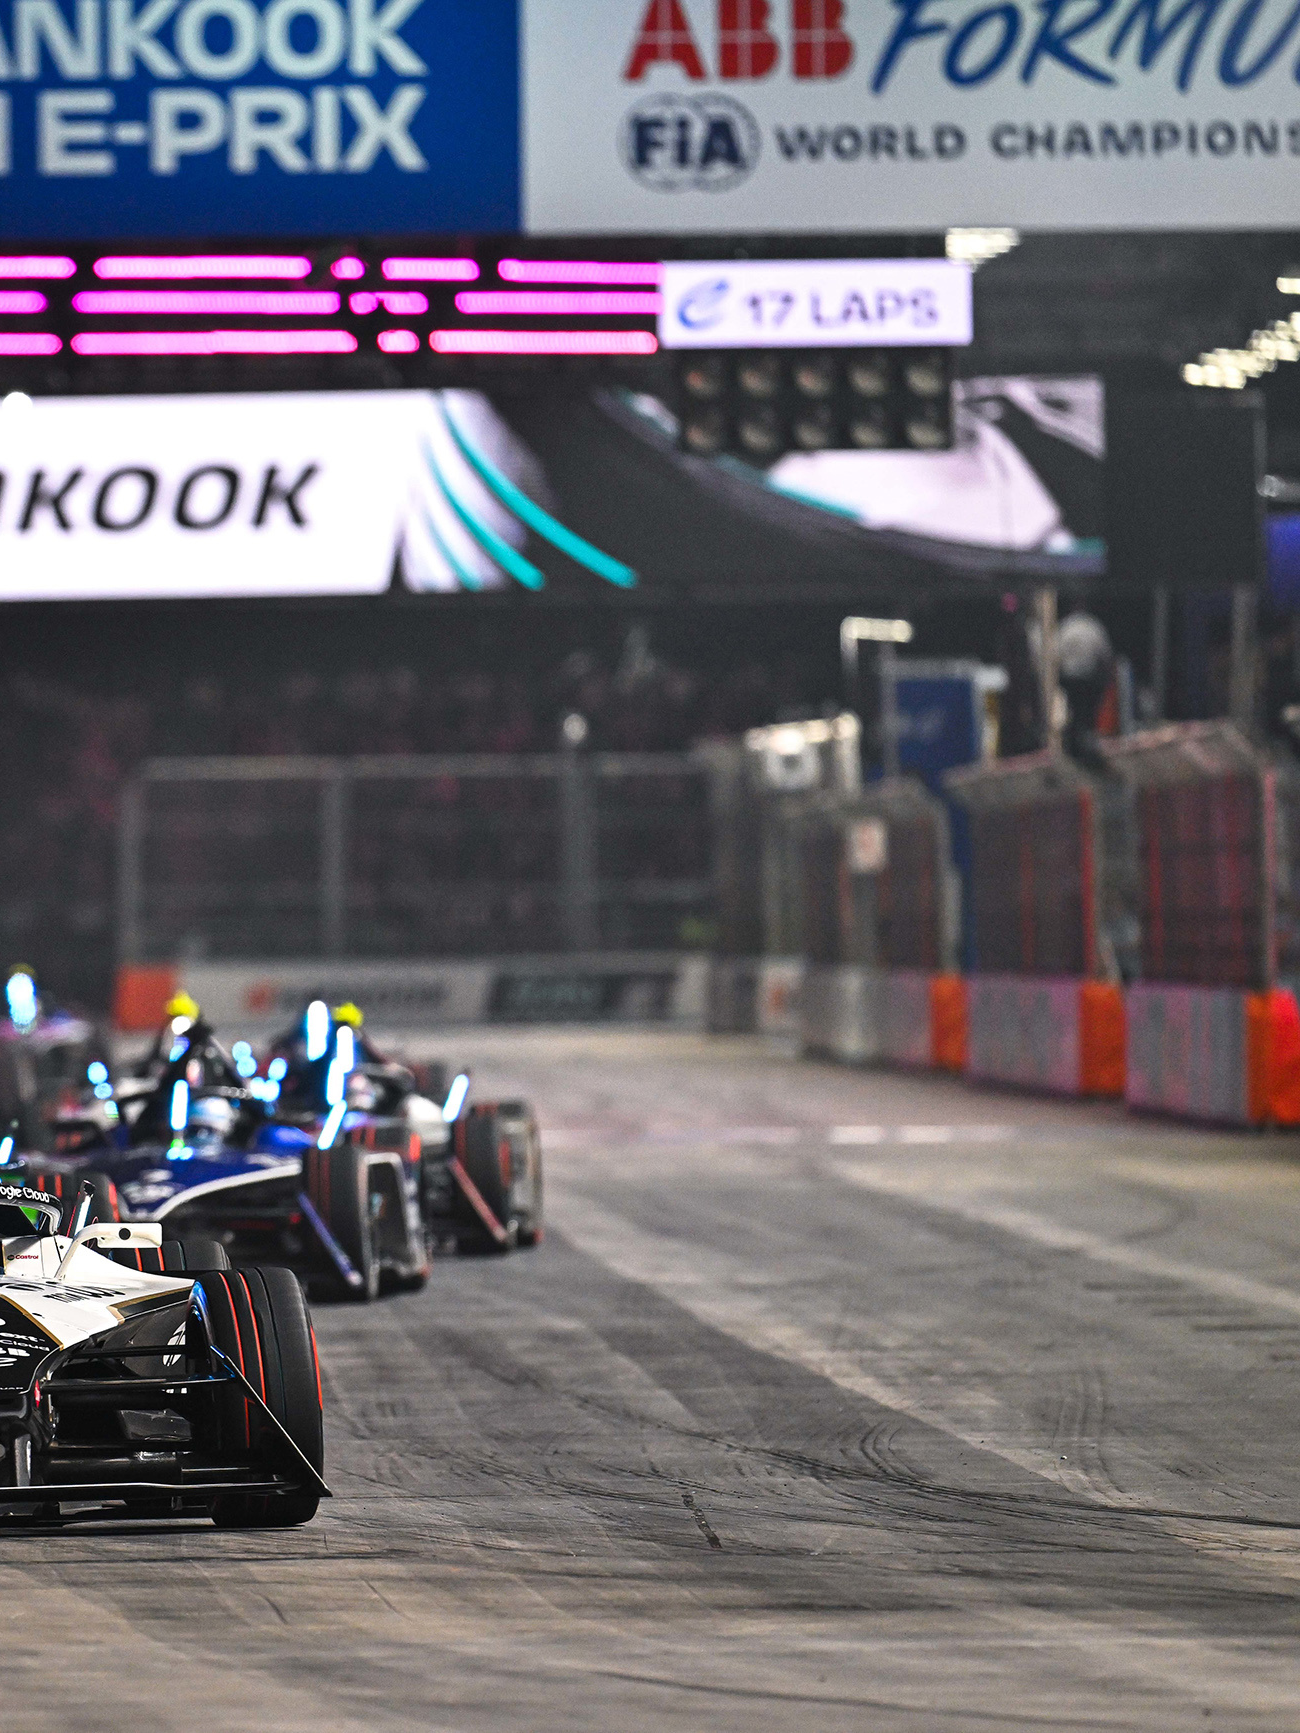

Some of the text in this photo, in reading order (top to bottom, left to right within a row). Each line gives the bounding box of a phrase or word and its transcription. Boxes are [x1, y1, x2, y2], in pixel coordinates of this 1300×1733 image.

[622, 0, 1300, 95] ABB FORMU
[38, 84, 429, 175] E-PRIX
[629, 113, 748, 171] FIA
[773, 123, 968, 162] WORLD
[743, 291, 795, 328] 17
[810, 288, 940, 328] LAPS
[22, 1187, 50, 1203] Cloud
